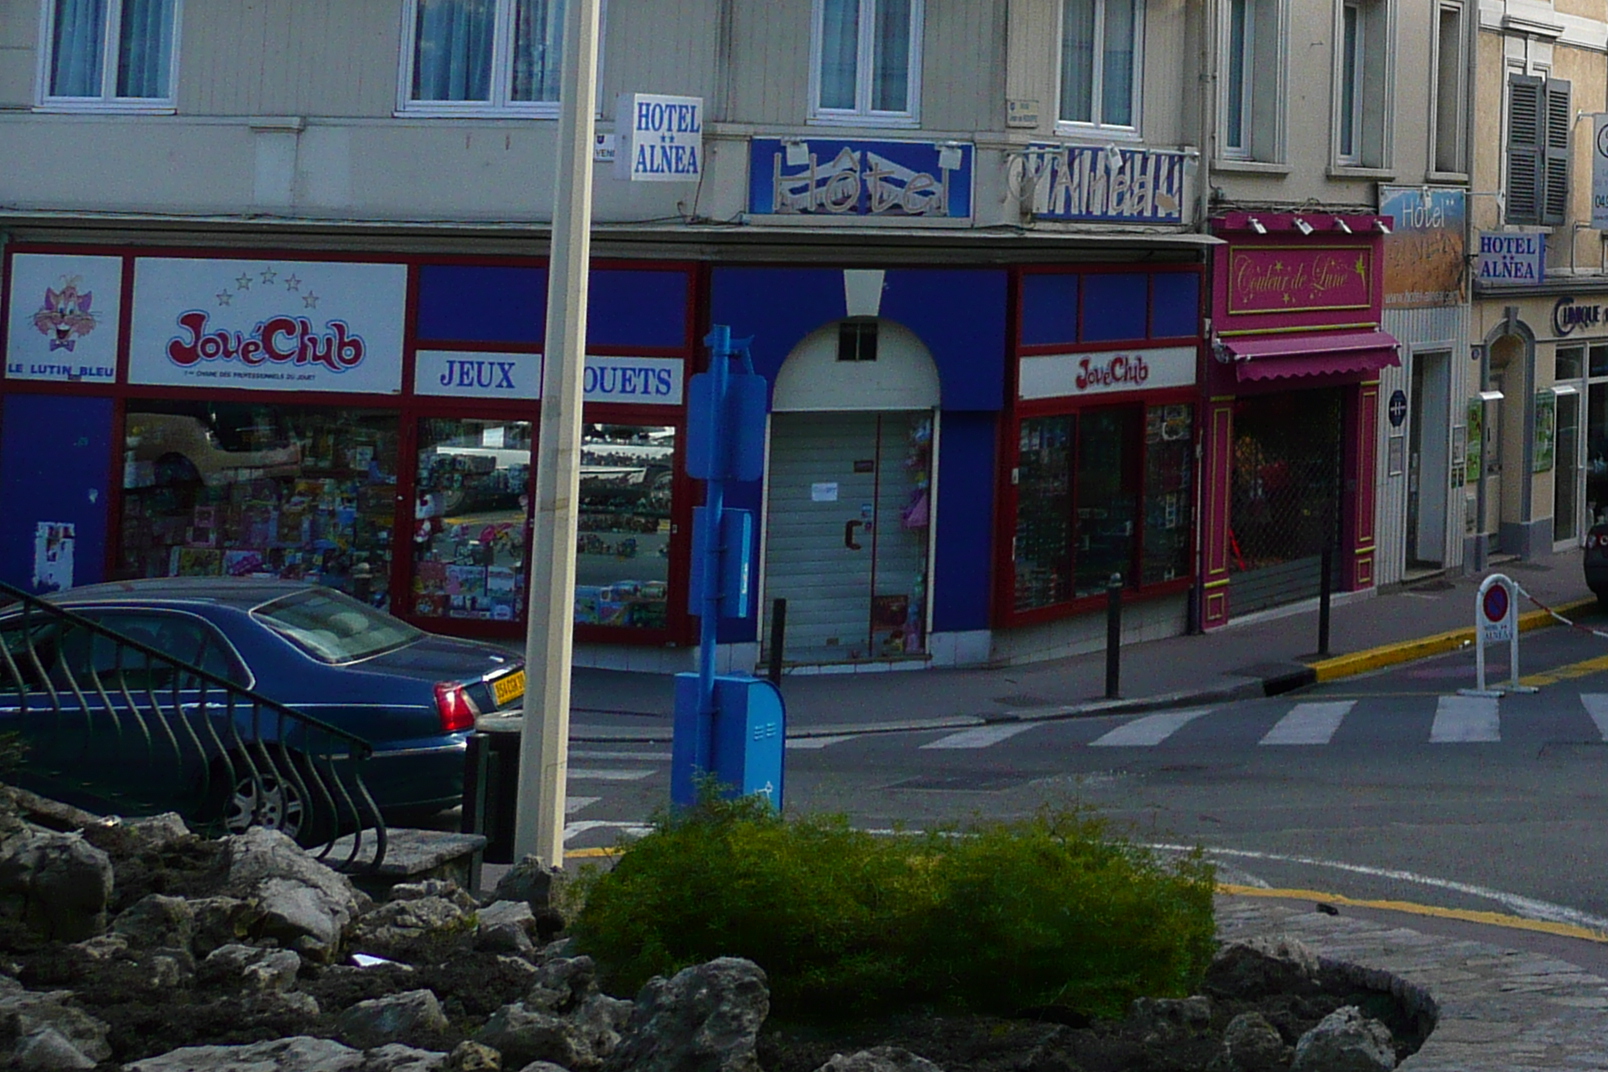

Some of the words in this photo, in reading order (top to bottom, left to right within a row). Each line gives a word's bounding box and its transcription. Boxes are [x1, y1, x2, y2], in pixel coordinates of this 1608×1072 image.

[636, 102, 701, 133] HOTEL
[634, 144, 699, 174] ALNEA
[772, 146, 950, 215] Hôtel
[1480, 236, 1536, 255] HOTEL
[1291, 262, 1307, 289] de
[1480, 260, 1535, 279] ALNEA
[1552, 296, 1601, 337] CLINIQUE
[167, 311, 366, 372] JouéClub
[8, 363, 24, 374] LE
[30, 364, 73, 376] LUTIN
[79, 365, 115, 378] BLEU
[439, 359, 517, 390] JEUX
[583, 366, 673, 397] OUETS
